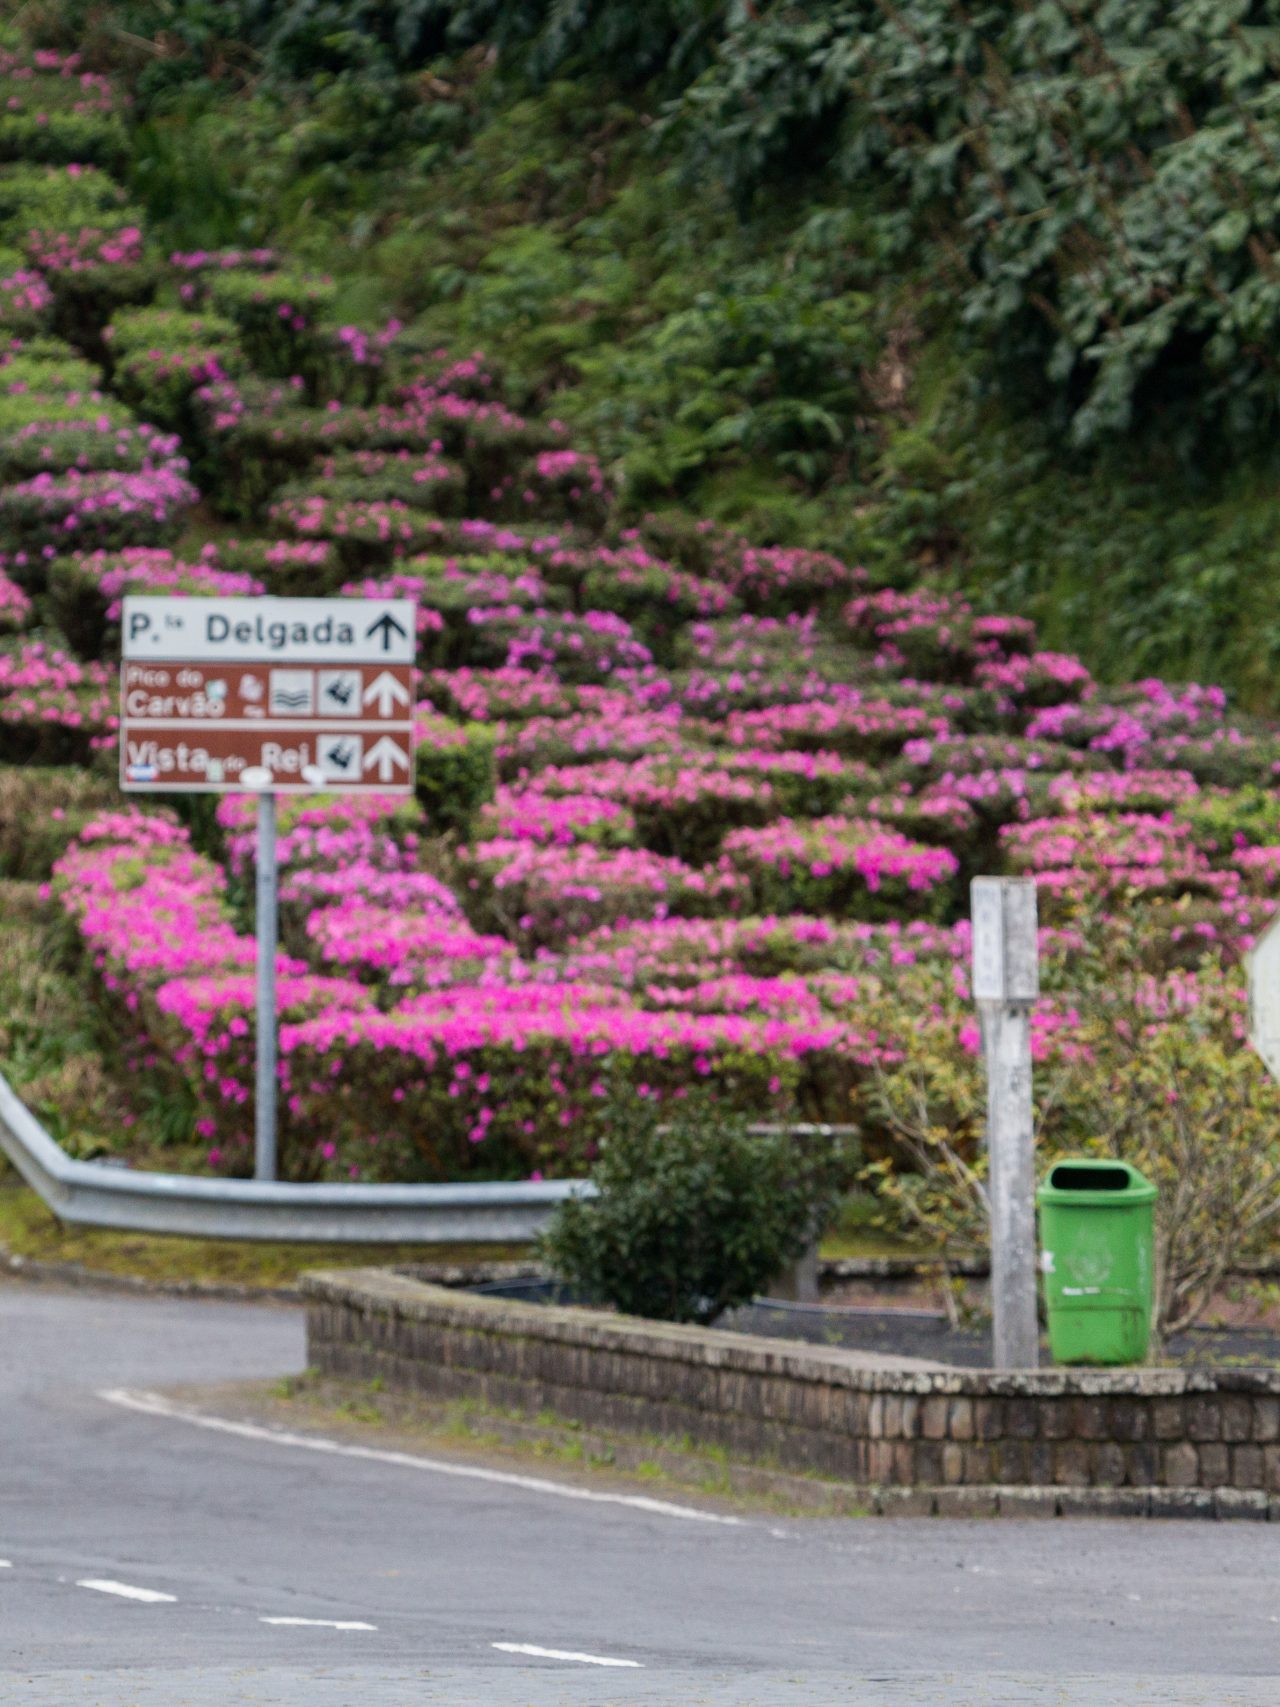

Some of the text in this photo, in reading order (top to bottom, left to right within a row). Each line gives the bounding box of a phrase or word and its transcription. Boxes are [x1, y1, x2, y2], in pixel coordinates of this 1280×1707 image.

[205, 613, 355, 649] Delgada
[127, 666, 204, 688] Pico do
[127, 689, 226, 718] Carvão
[127, 740, 209, 773] Vista
[260, 741, 310, 774] Rei
